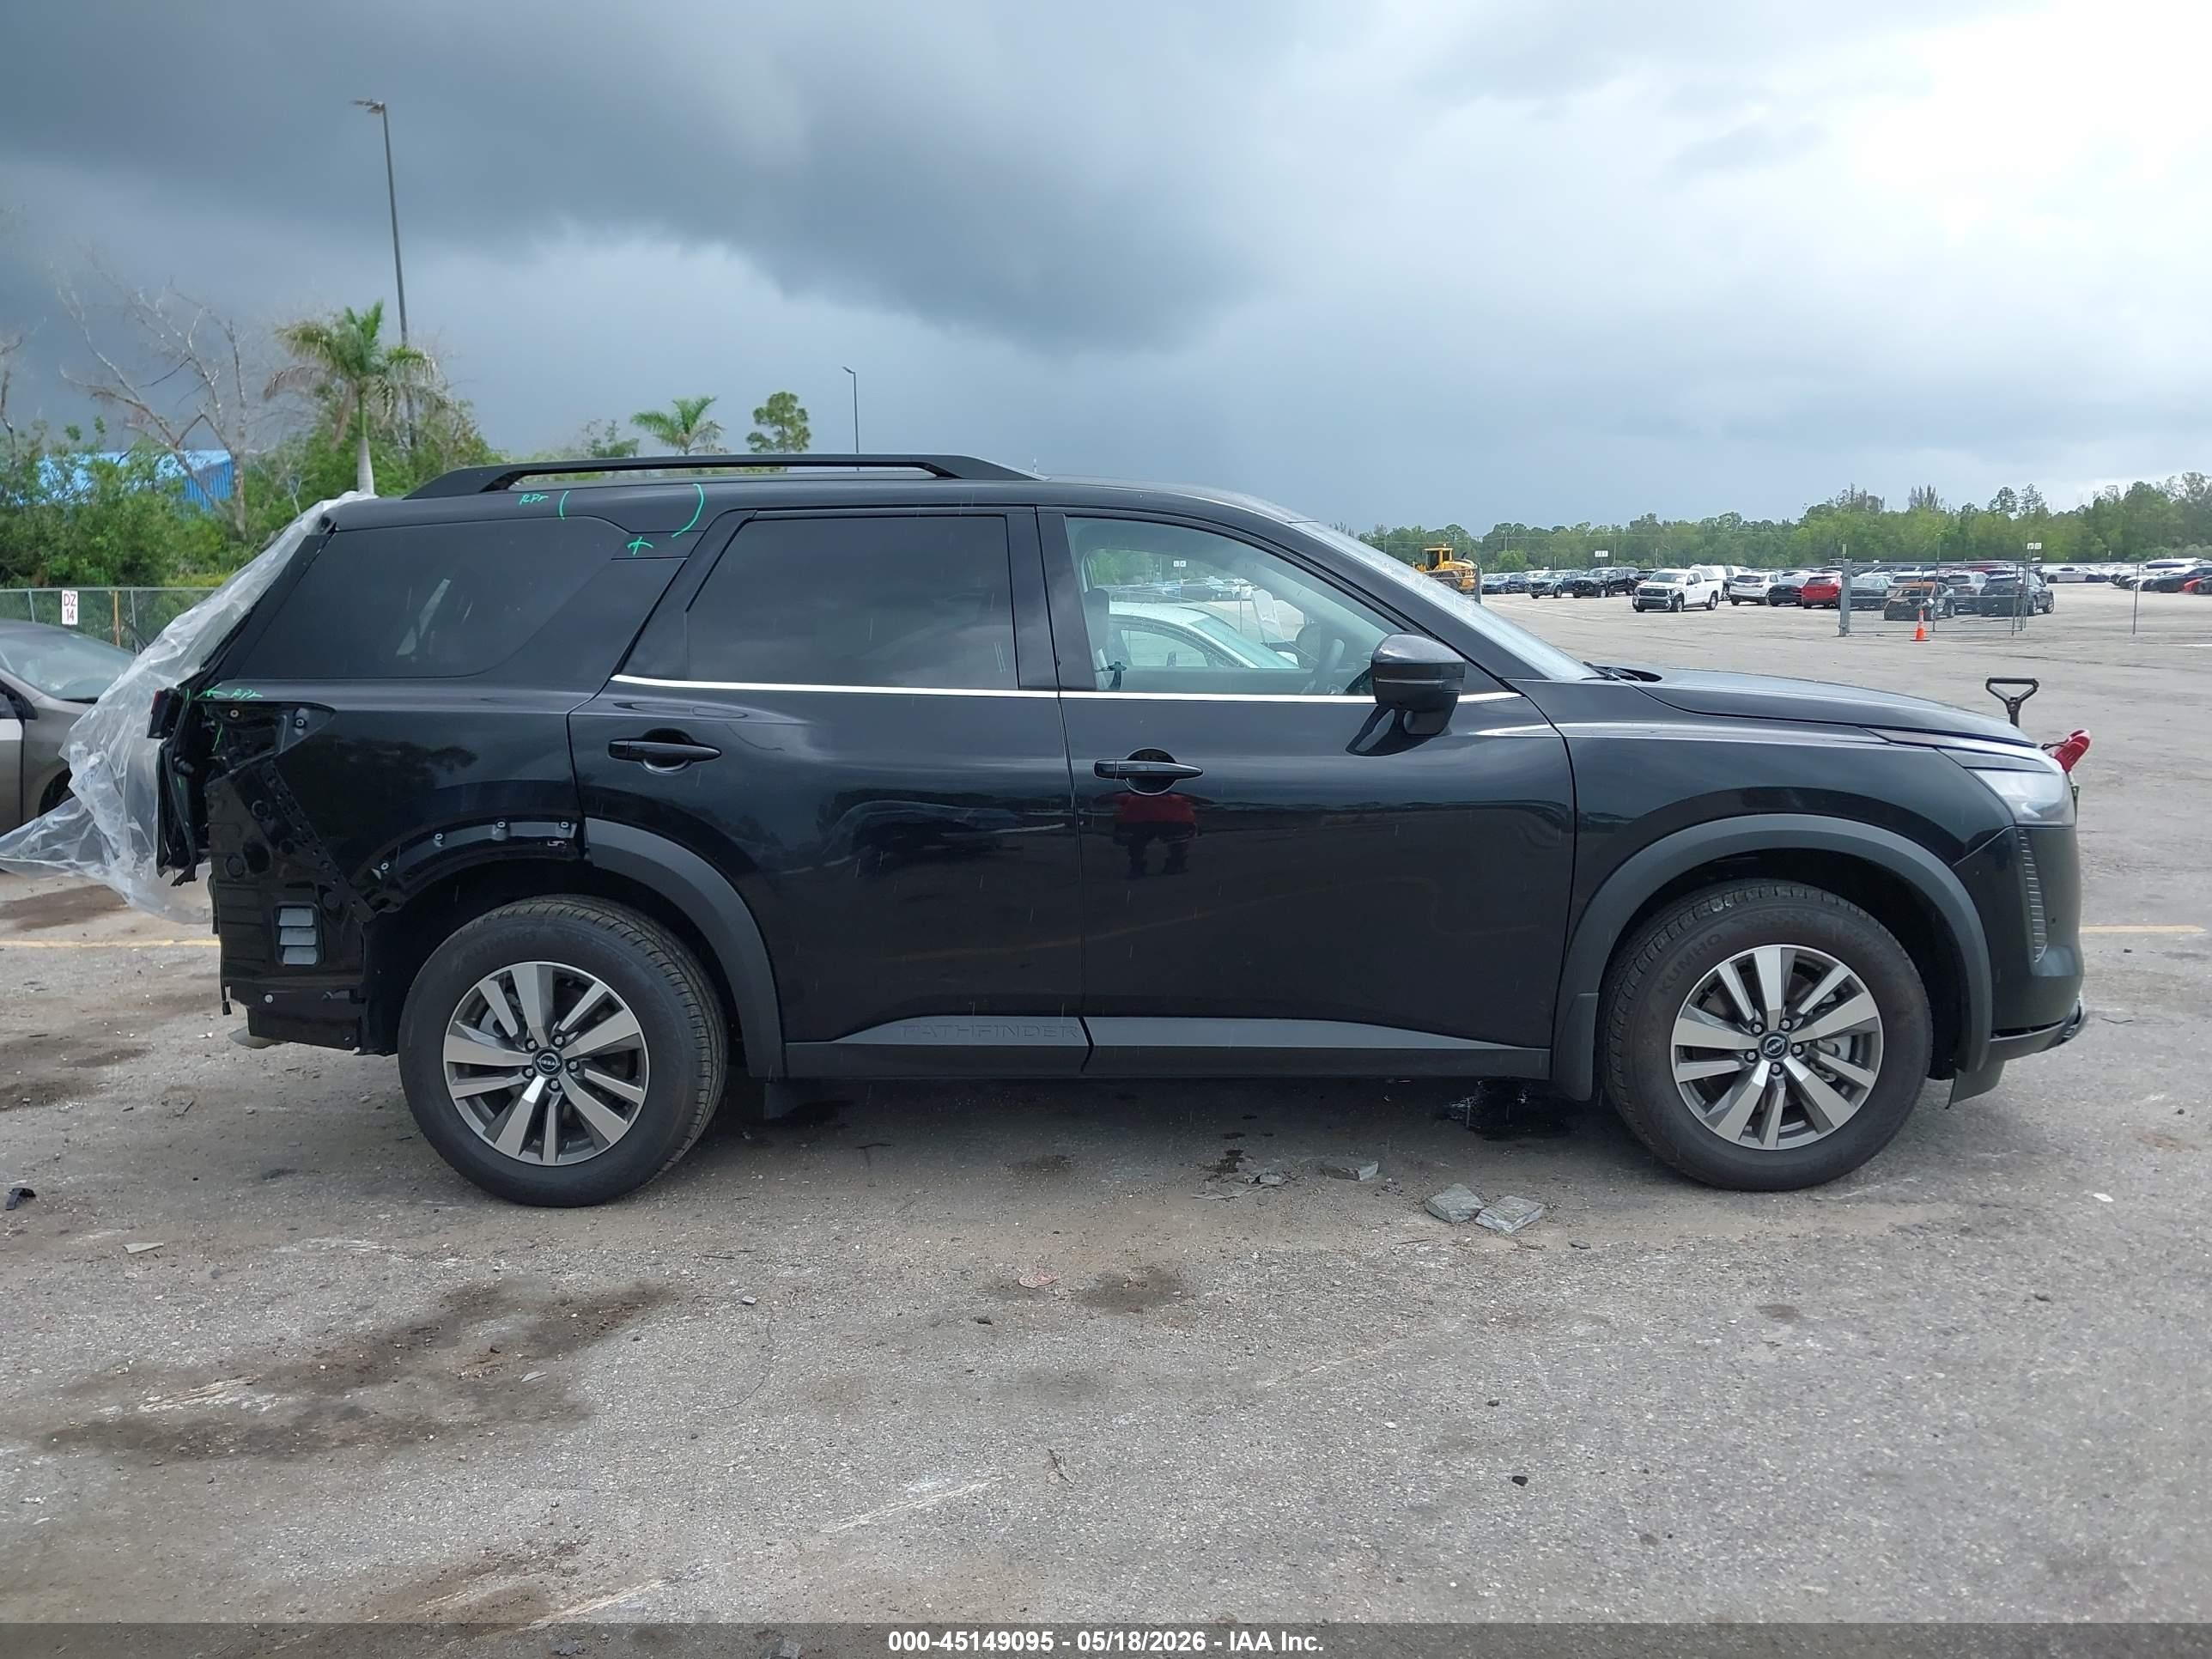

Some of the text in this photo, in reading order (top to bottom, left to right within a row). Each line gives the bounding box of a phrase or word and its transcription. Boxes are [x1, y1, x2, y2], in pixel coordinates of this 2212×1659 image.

[64, 593, 76, 606] DZ
[66, 609, 75, 621] 14
[1658, 933, 1722, 995] KUMHO
[900, 1024, 1079, 1038] PATHFINDER
